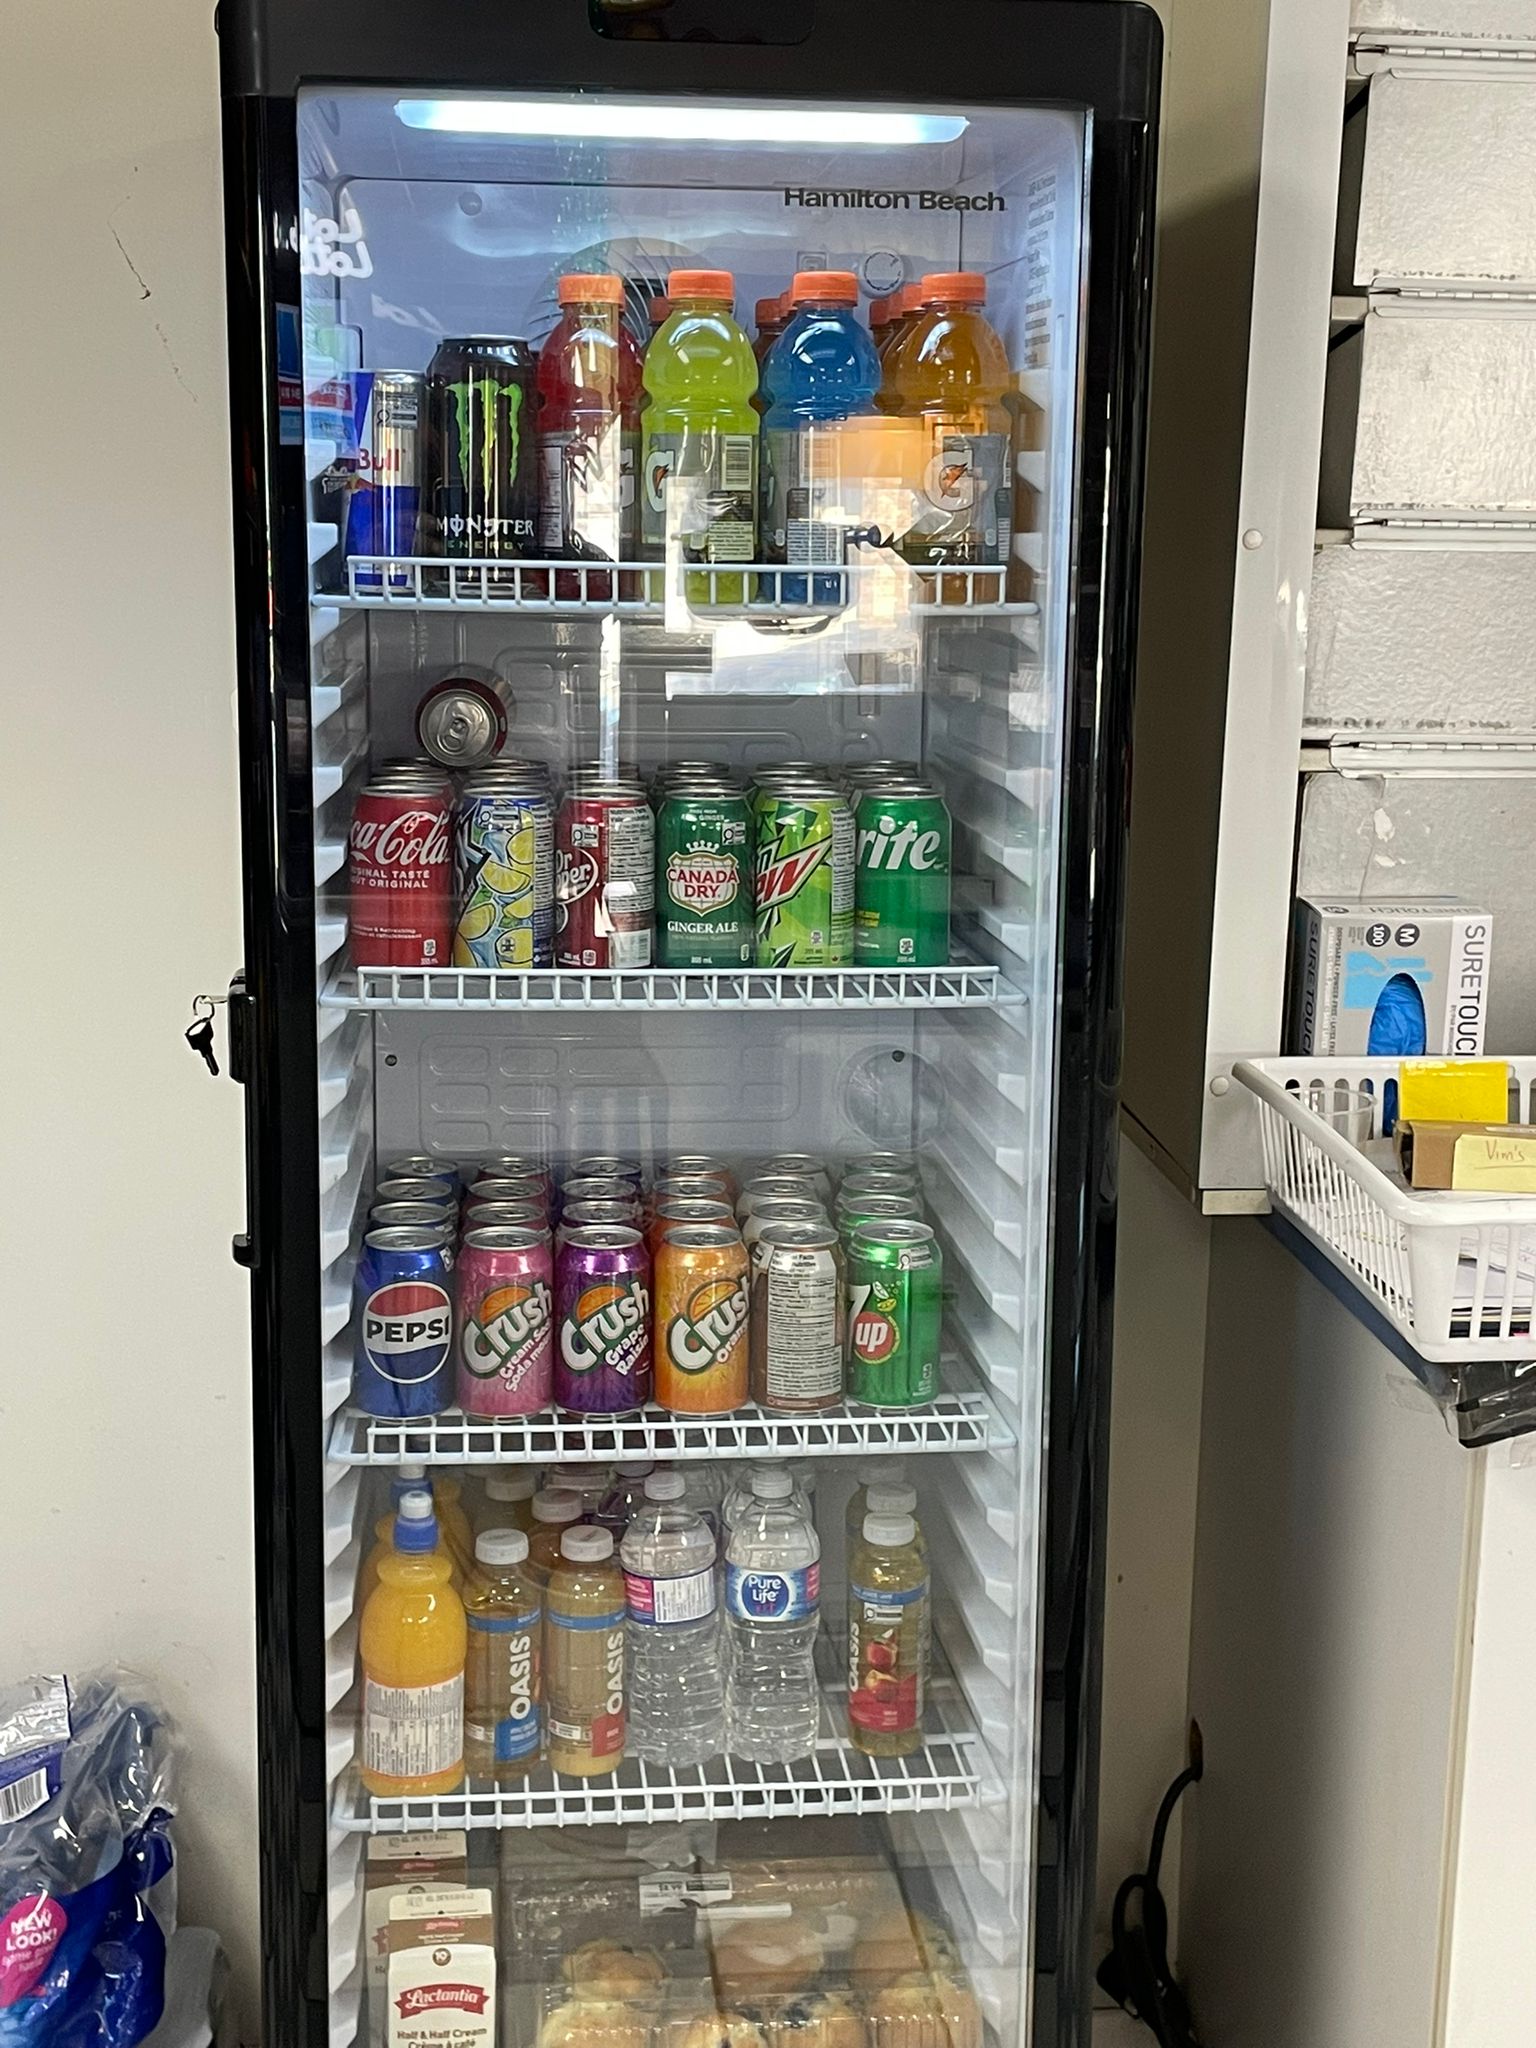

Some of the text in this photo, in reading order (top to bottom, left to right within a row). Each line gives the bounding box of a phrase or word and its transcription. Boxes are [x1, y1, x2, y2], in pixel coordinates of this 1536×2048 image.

[784, 187, 1005, 212] Hamilton Beach
[358, 448, 400, 472] Bull
[437, 514, 535, 537] MONSTER
[368, 878, 429, 888] ORIGINAL
[391, 869, 430, 879] TASTE
[667, 869, 739, 884] CANADA
[684, 884, 719, 898] DRY
[667, 920, 739, 933] GINGER ALE
[1372, 926, 1385, 946] 100
[1400, 928, 1415, 943] M
[366, 1315, 450, 1343] PEPSI
[463, 1282, 552, 1374] Crush
[561, 1282, 649, 1371] Crush
[855, 1322, 888, 1352] up
[604, 1324, 645, 1367] Grape
[499, 1339, 536, 1380] Cream
[505, 1363, 533, 1392] Soda
[748, 1575, 782, 1591] Pure
[752, 1589, 777, 1602] Life
[509, 1635, 532, 1720] OASIS
[606, 1631, 624, 1715] OASIS
[404, 1988, 479, 2010] Lactantia
[396, 2030, 418, 2040] Half
[429, 2029, 451, 2039] Half
[452, 2027, 488, 2038] Cream
